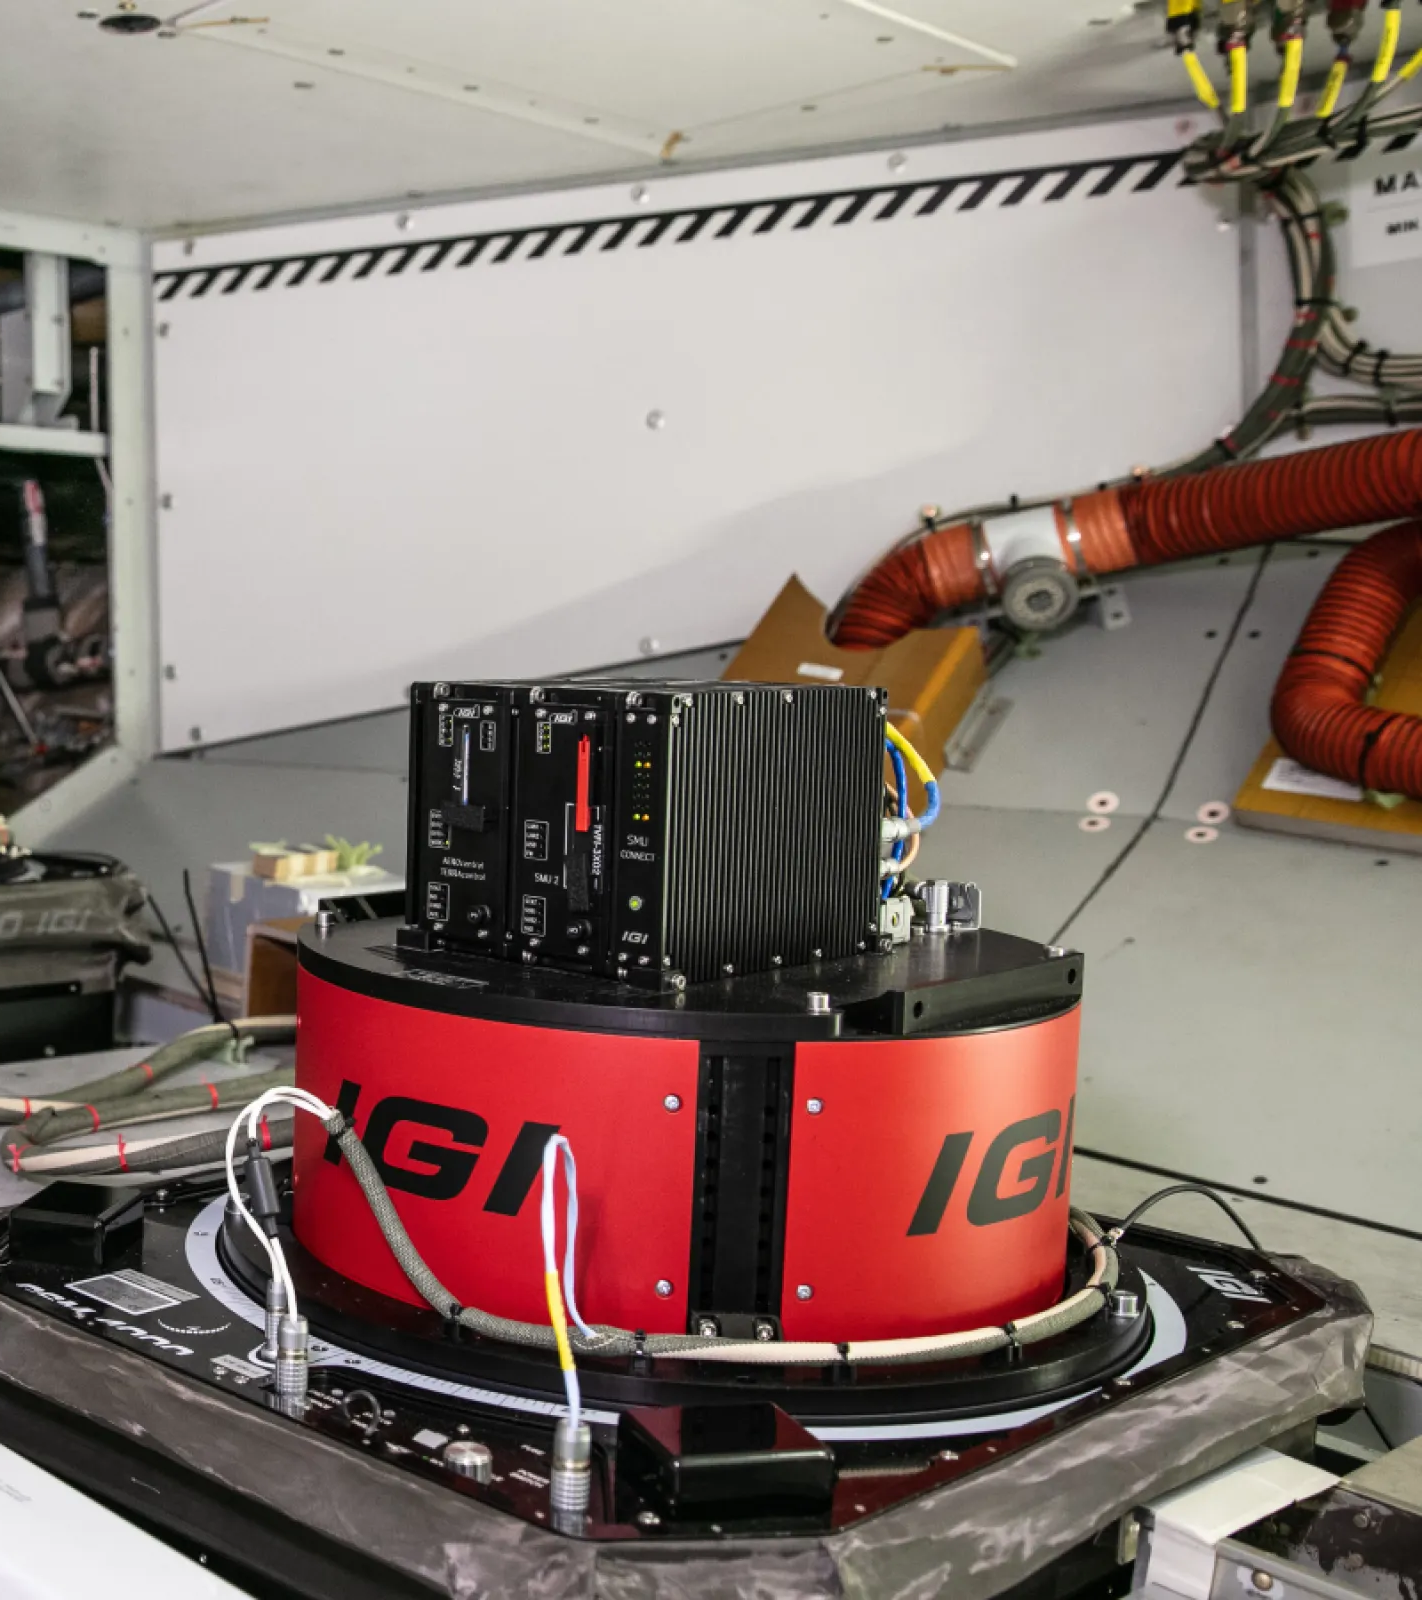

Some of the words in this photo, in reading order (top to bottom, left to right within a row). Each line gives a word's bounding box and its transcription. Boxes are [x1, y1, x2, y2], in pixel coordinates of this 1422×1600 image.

[626, 834, 650, 847] SMU
[620, 849, 656, 862] CONNECT
[534, 872, 553, 884] SMU
[621, 930, 650, 945] IGI
[323, 1079, 561, 1217] IGI
[1185, 1265, 1273, 1304] IGI
